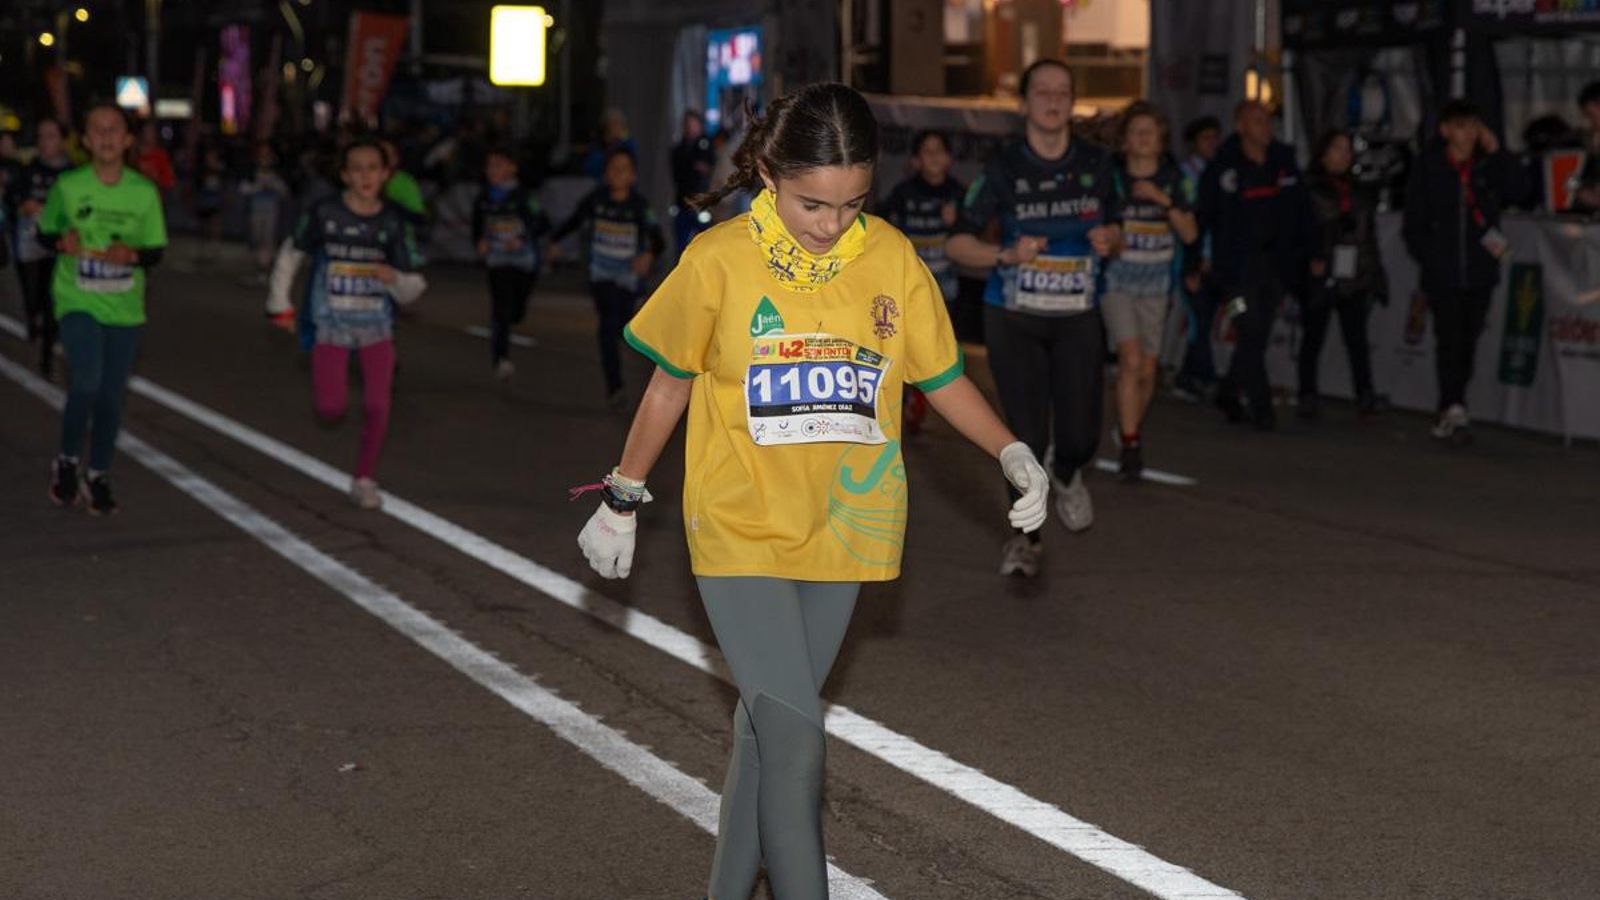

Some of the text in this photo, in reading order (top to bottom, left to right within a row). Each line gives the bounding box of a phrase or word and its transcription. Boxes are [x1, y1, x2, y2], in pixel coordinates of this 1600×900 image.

[1015, 203, 1048, 220] SAN
[1021, 271, 1086, 291] 10263
[751, 312, 781, 334] Jaén
[778, 339, 805, 359] 42
[752, 365, 877, 404] 11095
[838, 403, 853, 412] DÍAZ
